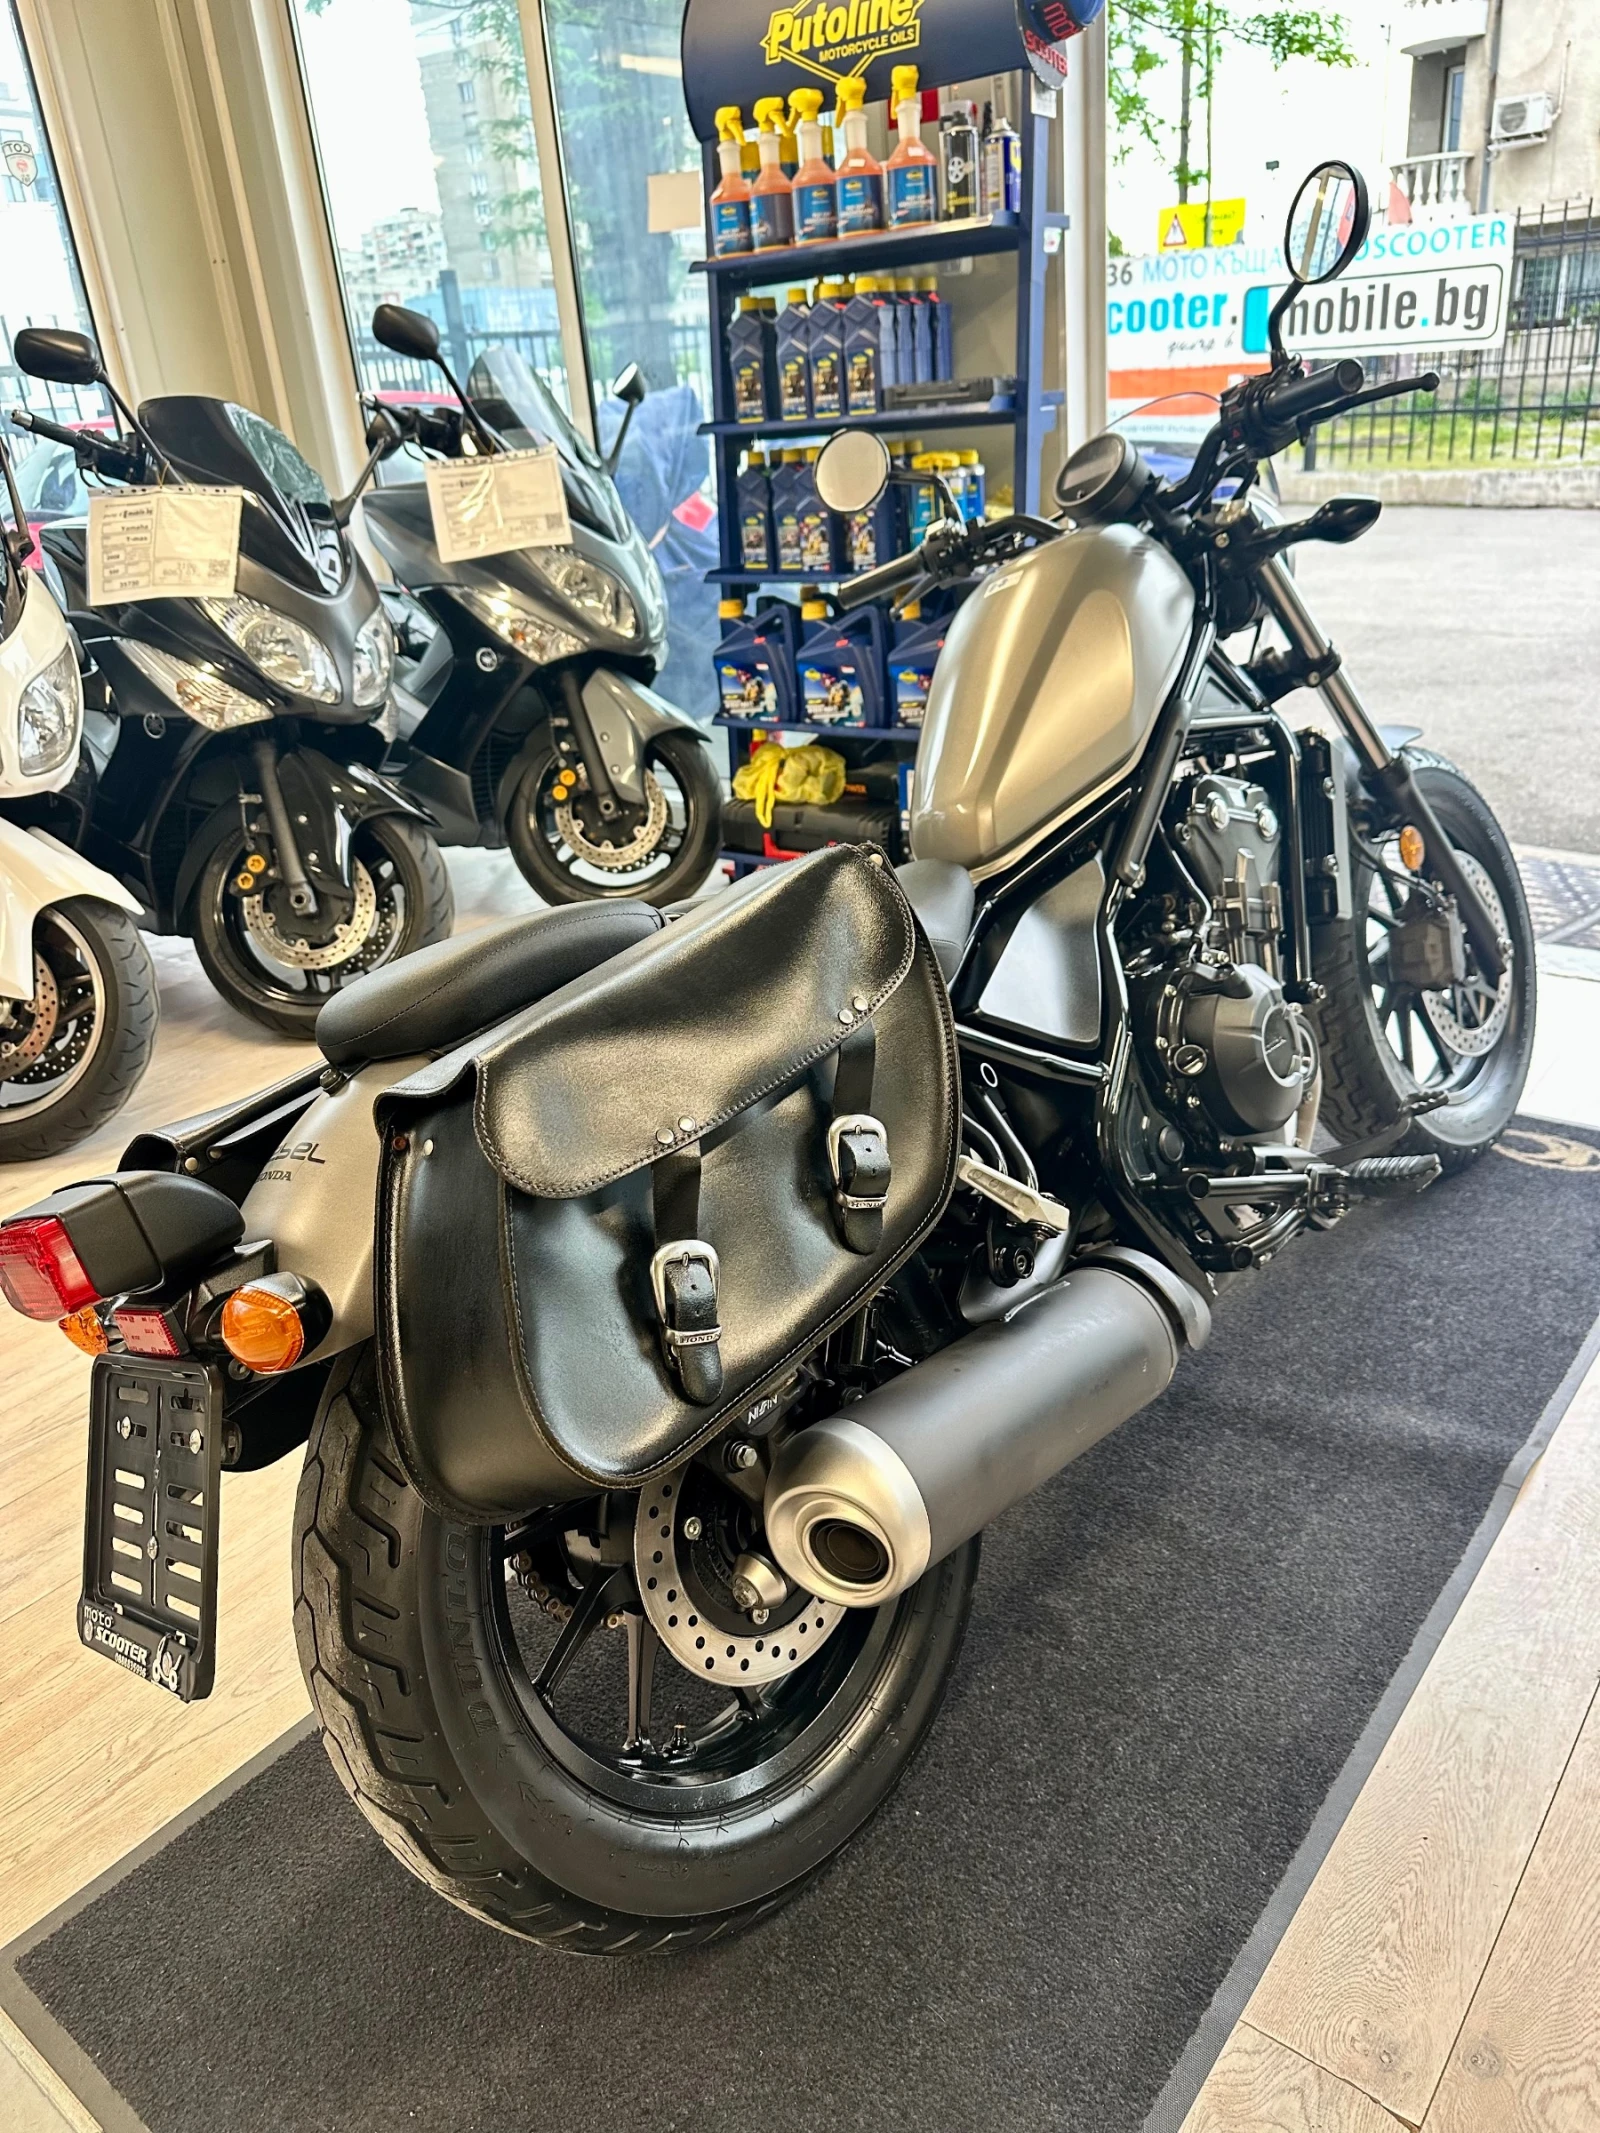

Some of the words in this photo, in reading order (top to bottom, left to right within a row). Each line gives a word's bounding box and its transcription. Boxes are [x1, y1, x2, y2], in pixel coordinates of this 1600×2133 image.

[769, 0, 915, 60] Putoline
[818, 35, 889, 63] MOTORCYCLE
[890, 28, 915, 46] OILS
[95, 1625, 149, 1666] SCOOTER
